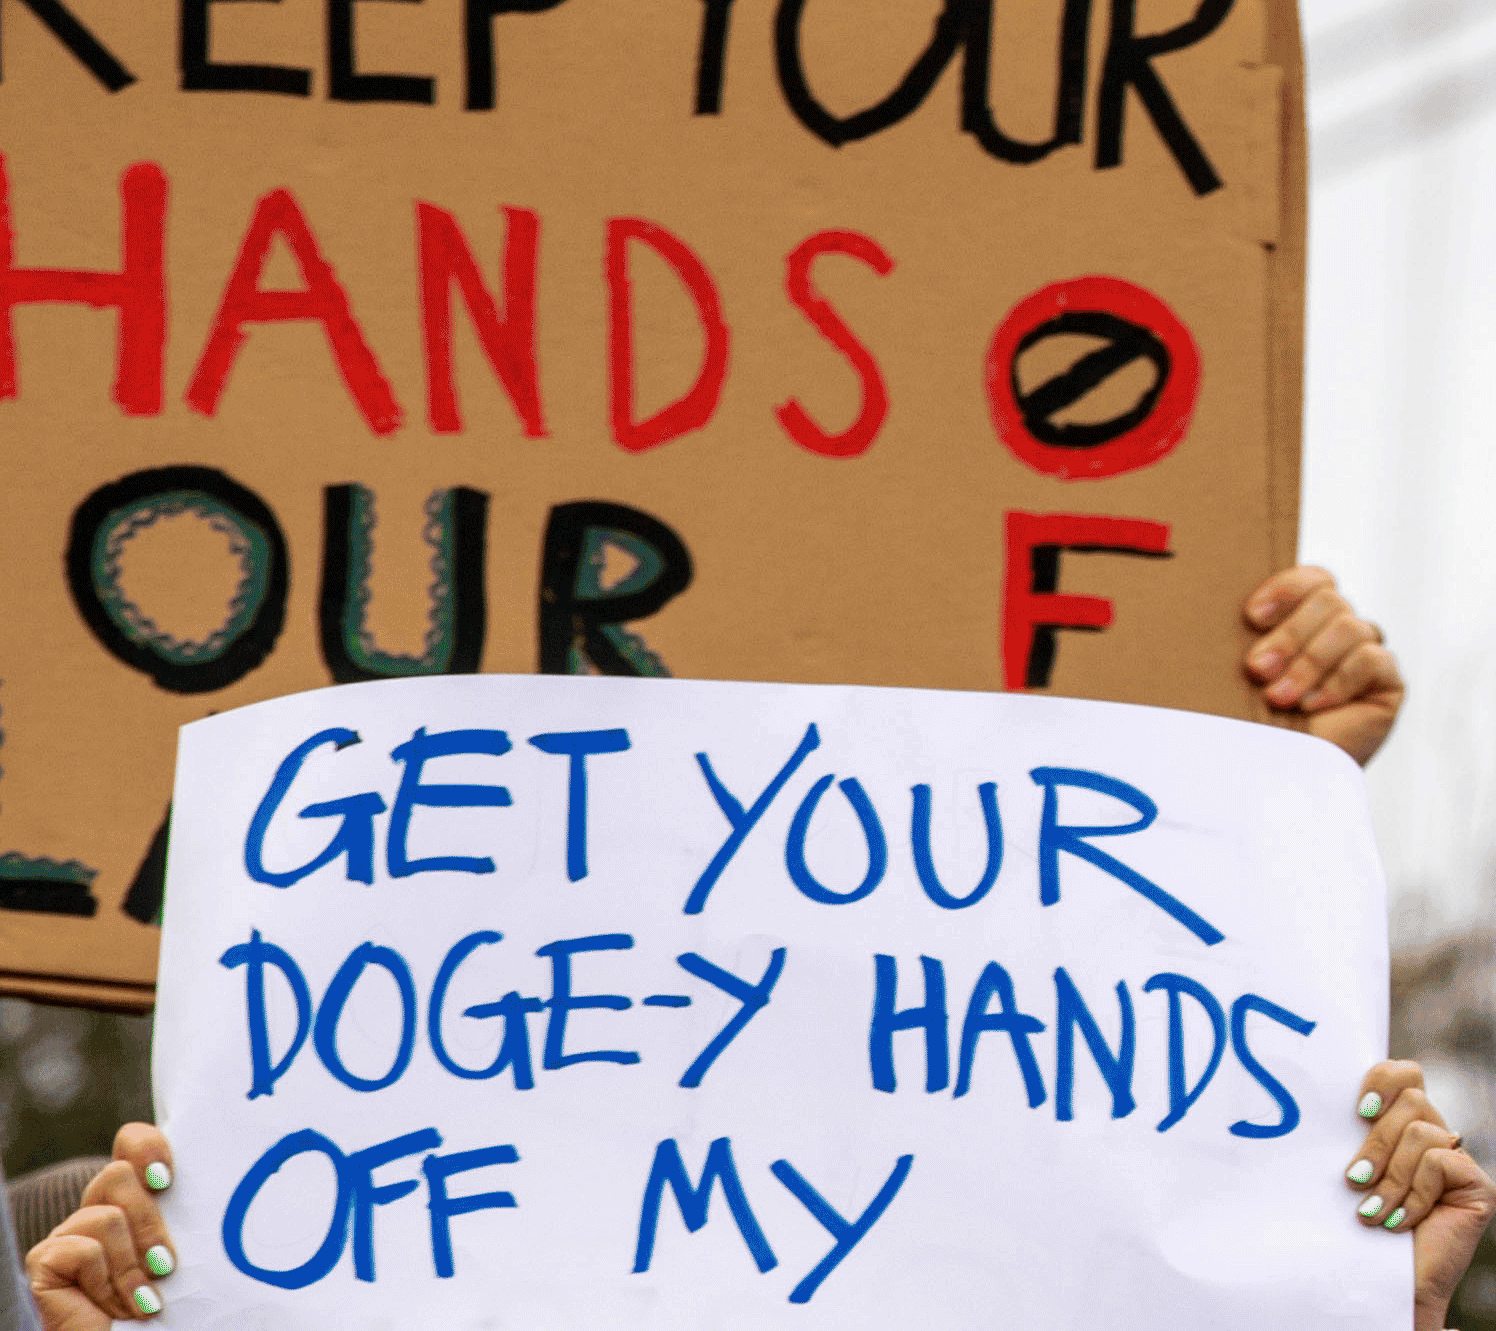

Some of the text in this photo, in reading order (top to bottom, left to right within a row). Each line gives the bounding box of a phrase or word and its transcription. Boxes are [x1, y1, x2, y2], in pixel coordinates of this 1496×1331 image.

[0, 152, 895, 459] HANDS
[63, 464, 695, 696] OUR
[246, 727, 631, 888] GET
[685, 723, 1224, 945] YOUR
[221, 930, 1315, 1138] DOGE-Y HANDS
[223, 1128, 913, 1303] OFF MY
